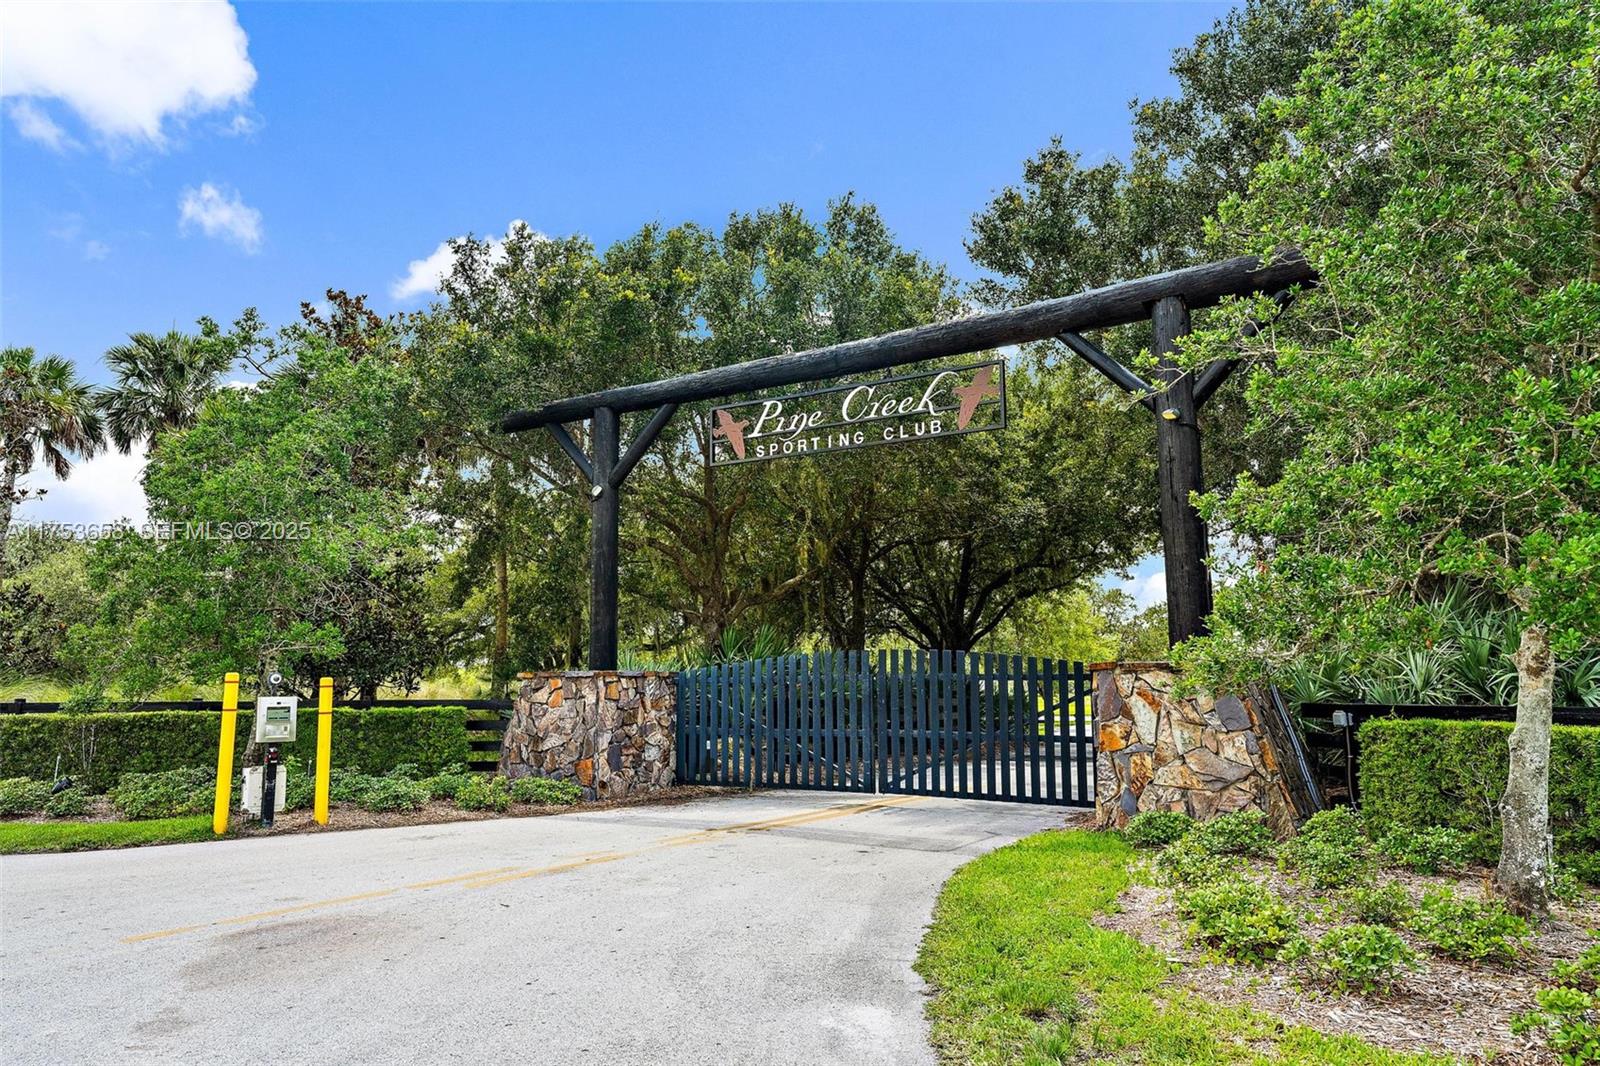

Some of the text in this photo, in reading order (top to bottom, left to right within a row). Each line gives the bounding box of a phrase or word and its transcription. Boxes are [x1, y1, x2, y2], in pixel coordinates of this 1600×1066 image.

[748, 371, 959, 441] Pine Creek
[756, 420, 943, 458] SPORTING CLUB
